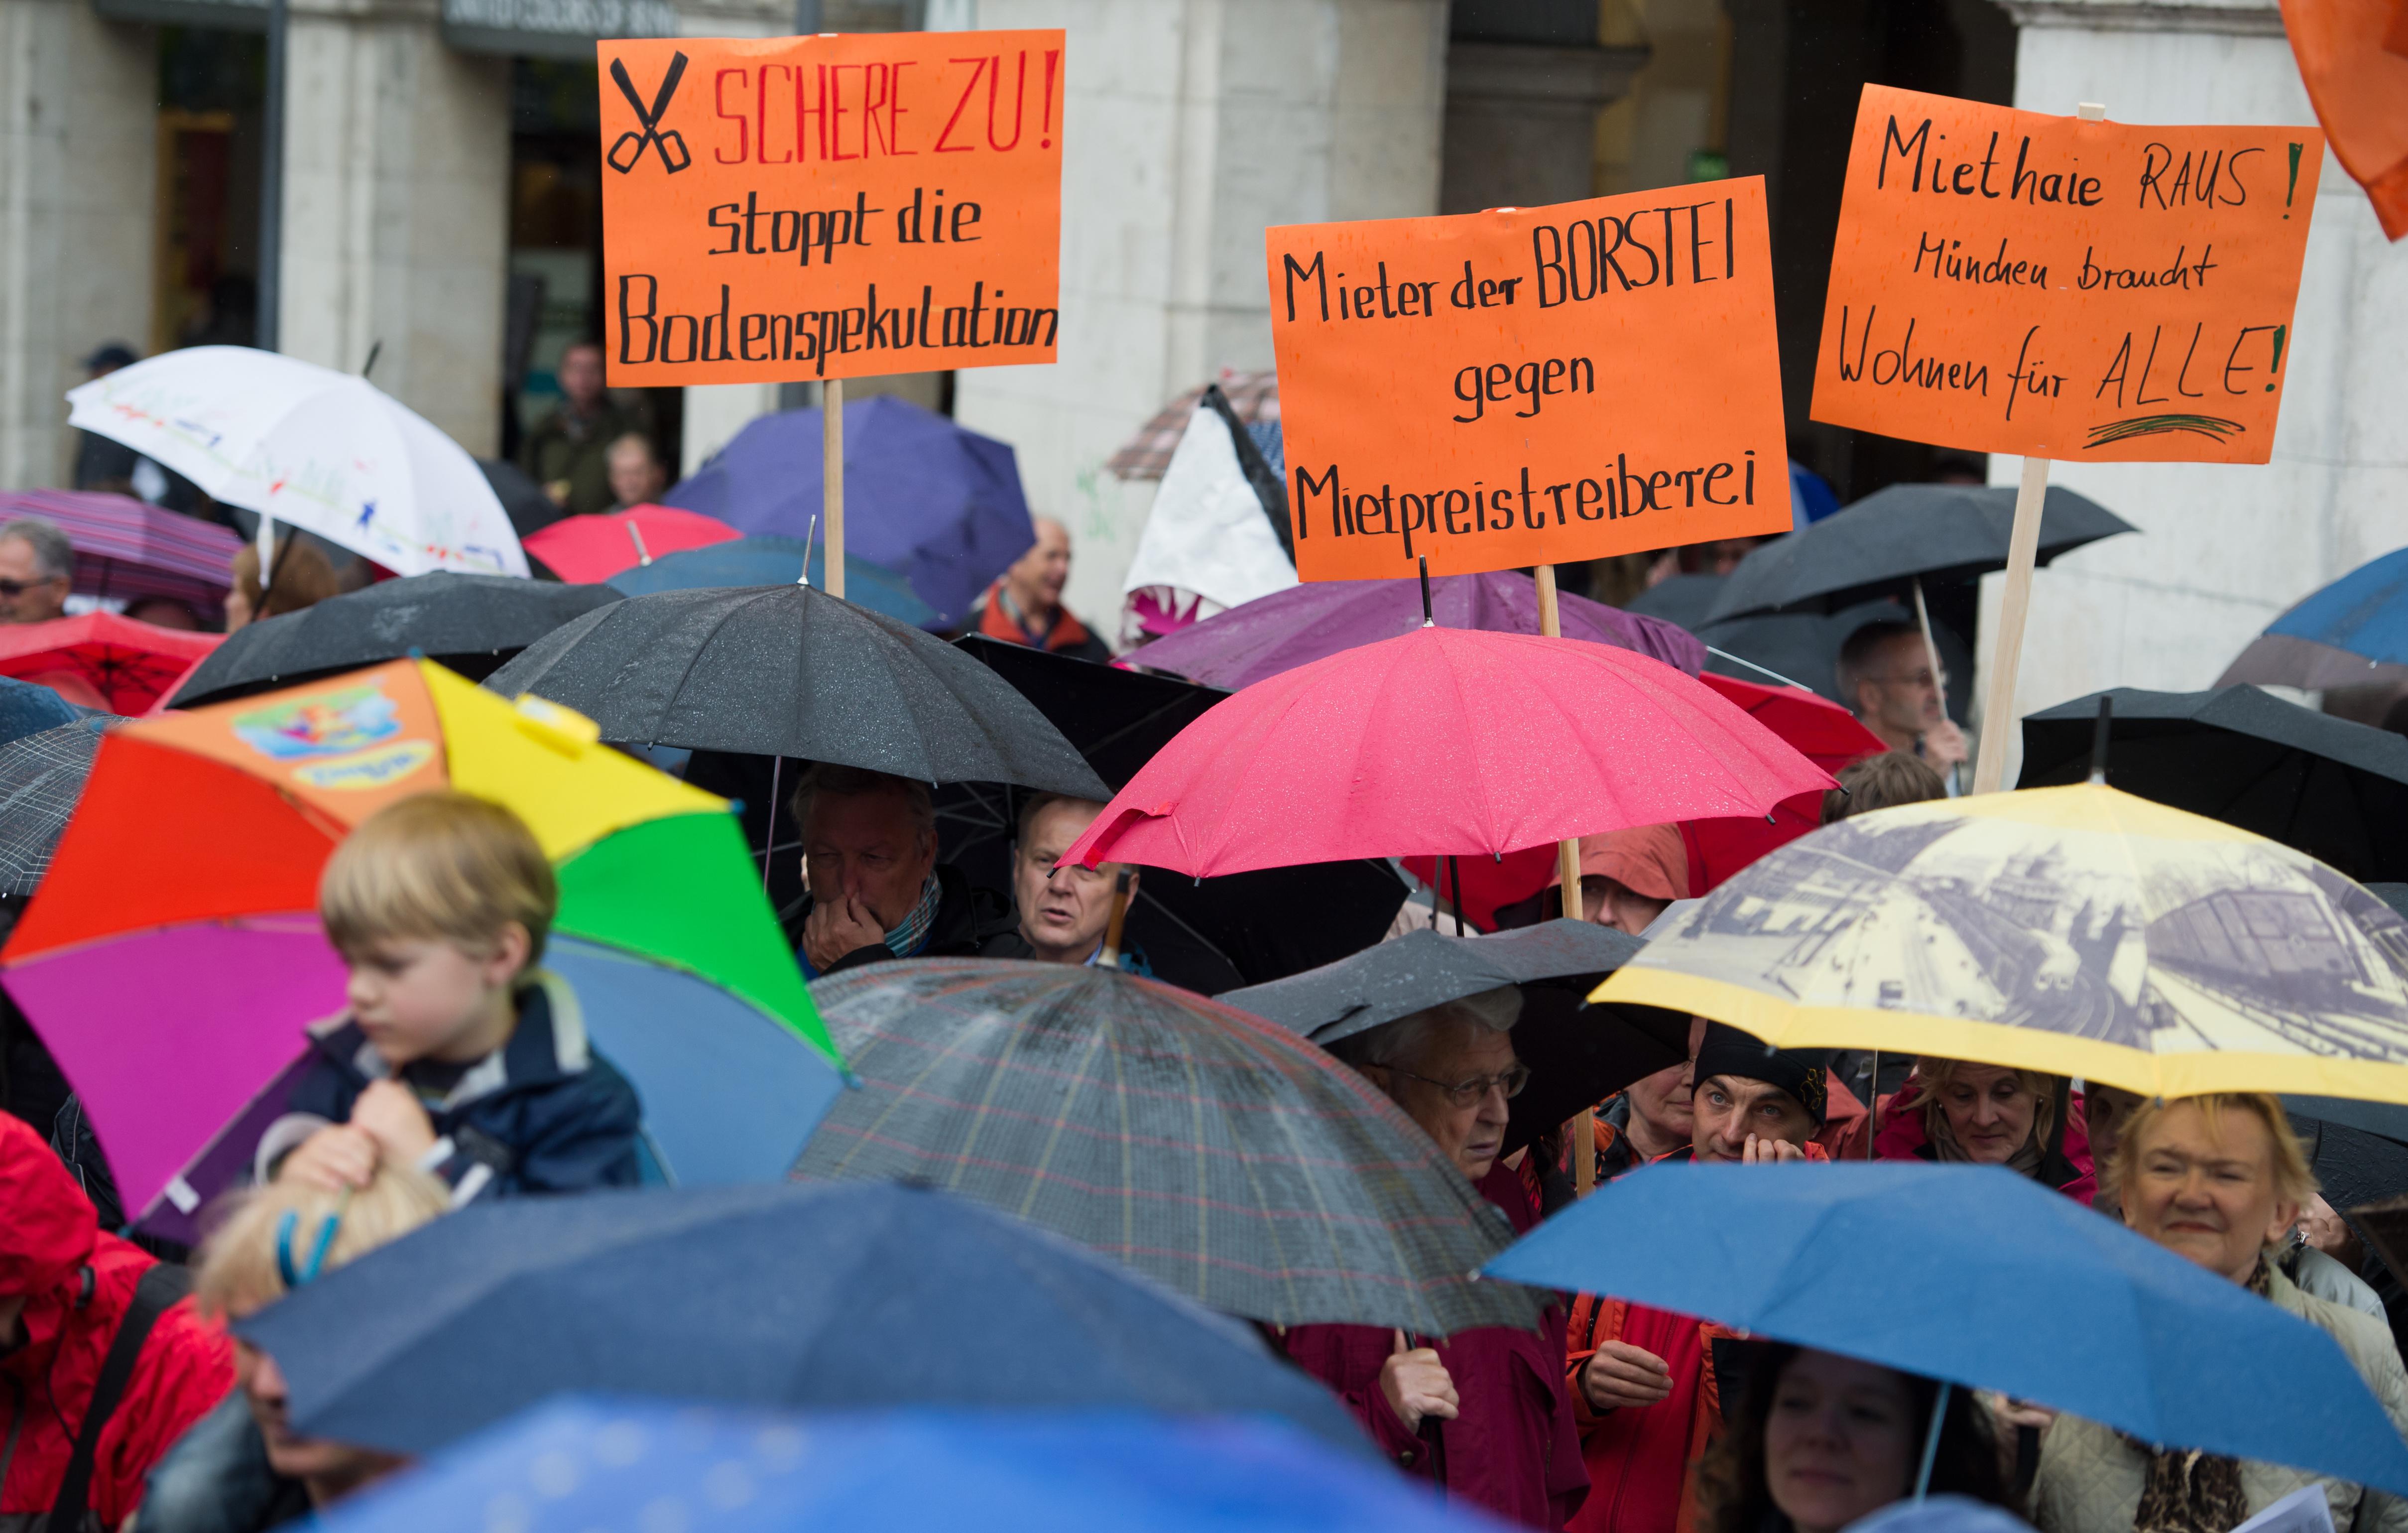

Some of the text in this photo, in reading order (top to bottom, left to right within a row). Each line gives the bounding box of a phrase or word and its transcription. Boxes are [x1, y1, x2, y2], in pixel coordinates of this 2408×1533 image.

[714, 49, 1060, 165] SCHERE ZU!
[1878, 114, 2105, 207] Miethaie
[708, 187, 982, 267] stoppt die
[1283, 197, 1734, 323] Mieter der BORSTEI
[1913, 231, 2219, 291] München braucht
[618, 274, 1059, 377] Bodenspekulation
[1839, 304, 2287, 422] Wohnen für ALLE!
[1452, 357, 1595, 424] gegen
[1295, 449, 1756, 560] Mietpreistreiberei
